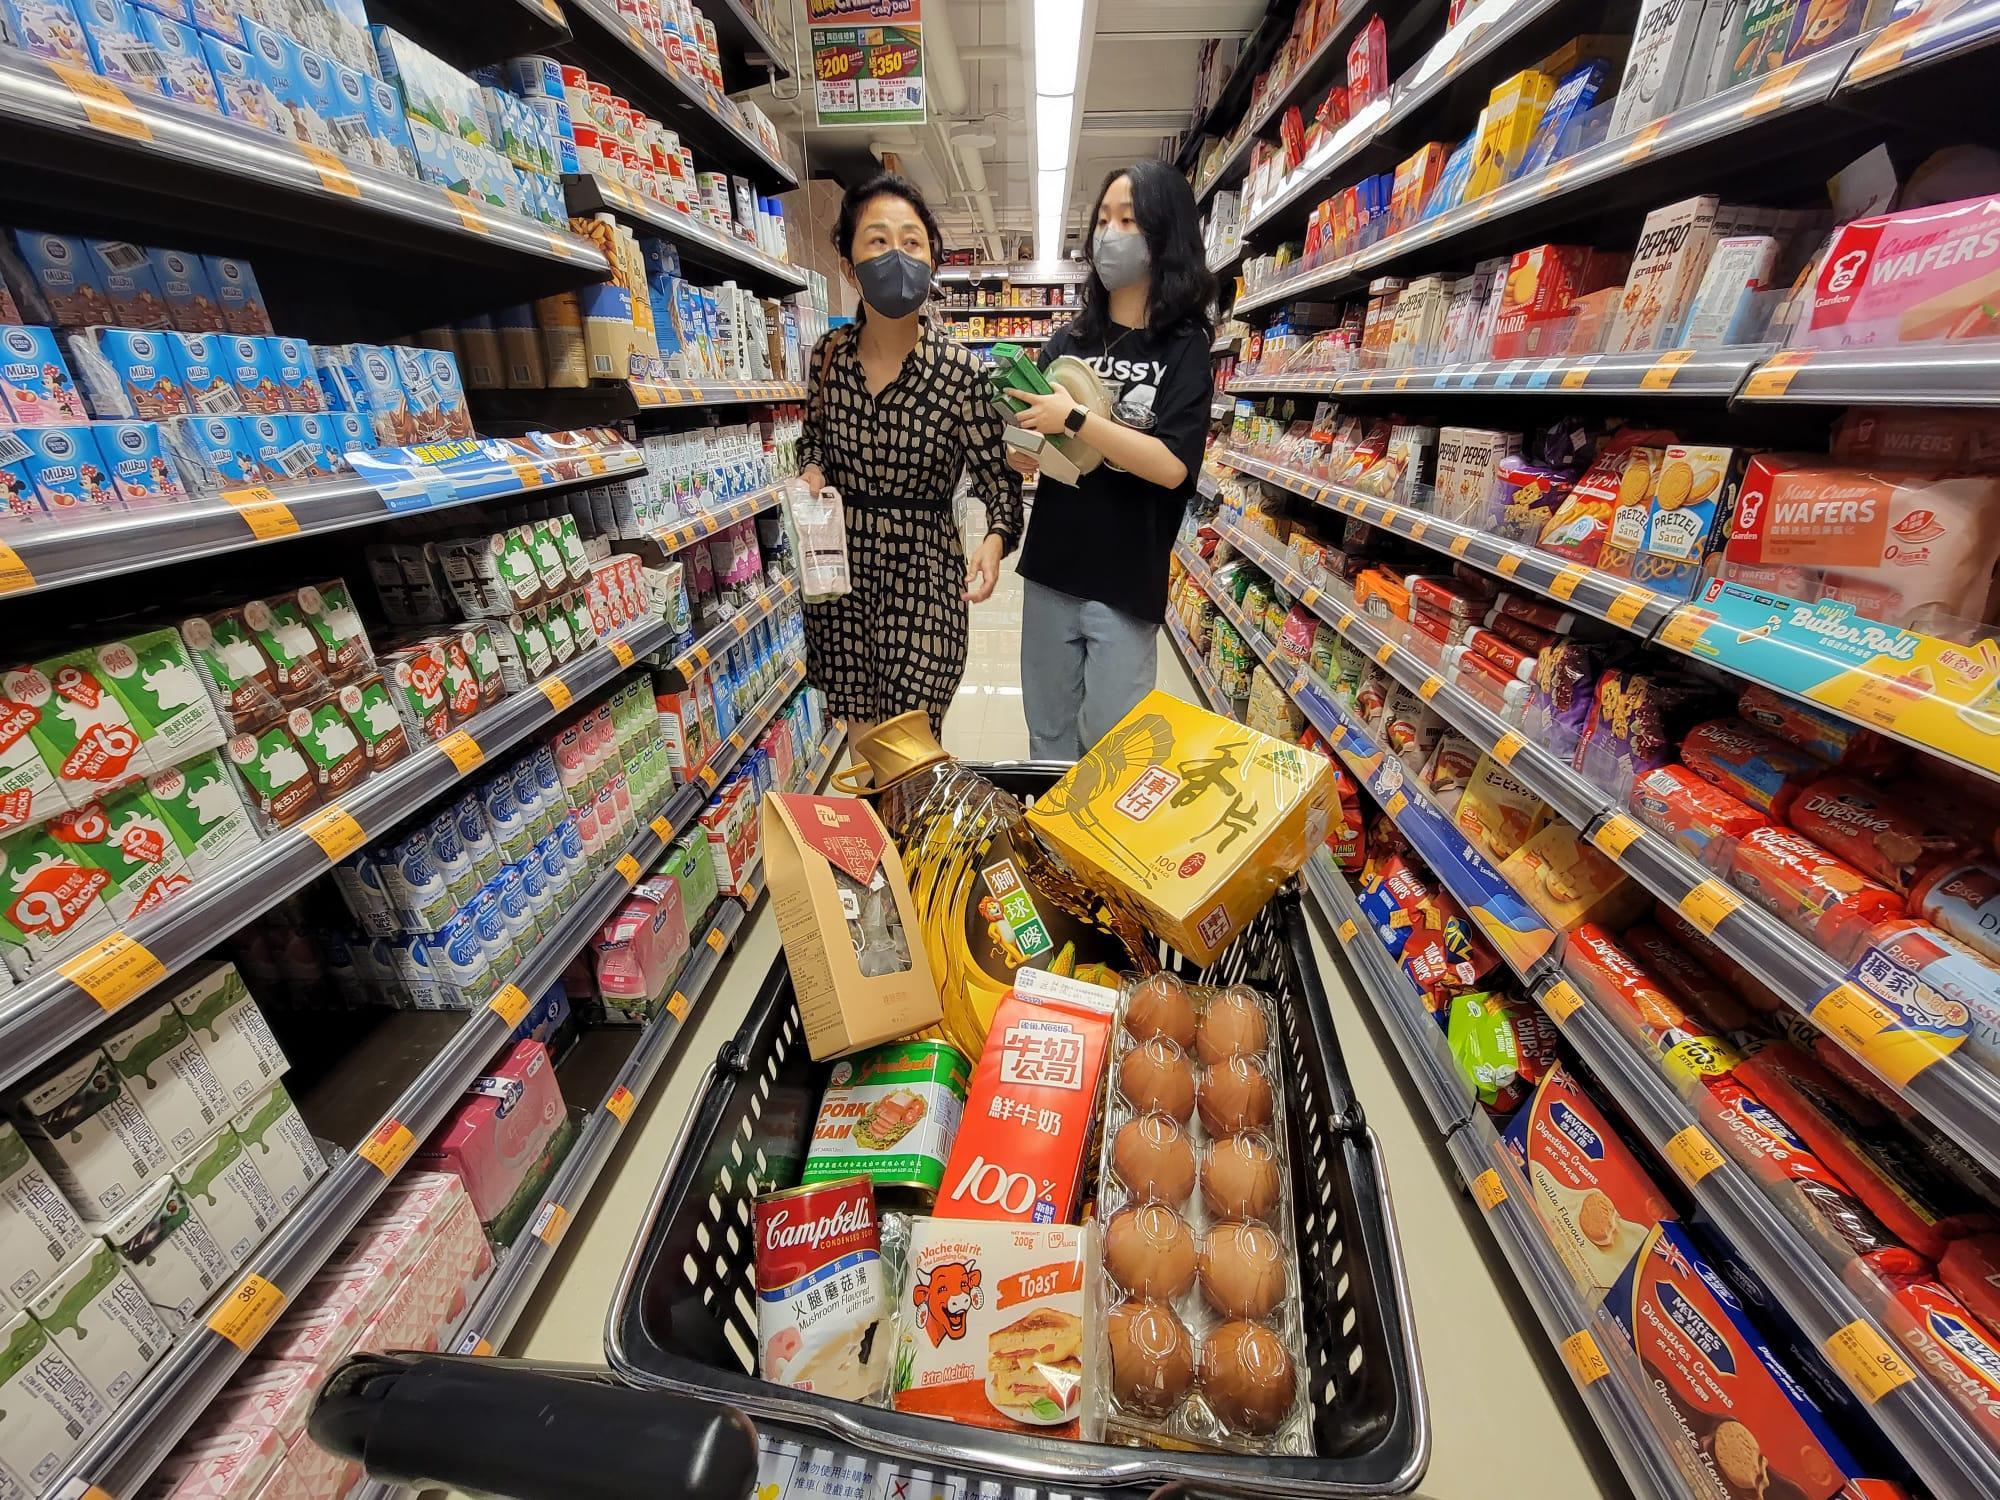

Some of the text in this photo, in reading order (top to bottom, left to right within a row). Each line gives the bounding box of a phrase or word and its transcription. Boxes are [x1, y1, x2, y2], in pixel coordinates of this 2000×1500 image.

[870, 2, 910, 16] Crazy Deal
[1745, 8, 1795, 36] almond
[1635, 222, 1691, 262] PEPERO
[1633, 259, 1673, 279] granola
[1814, 294, 1851, 309] Garden
[1495, 314, 1528, 335] MARIE
[5, 365, 37, 378] Milky
[131, 366, 154, 379] Milky
[188, 367, 208, 378] Milky
[238, 368, 257, 379] Milky
[212, 451, 231, 462] Milky
[1440, 442, 1460, 462] PEPERO
[1461, 444, 1493, 467] PEPERO
[44, 467, 76, 481] Milky
[120, 460, 146, 473] Milky
[1617, 509, 1648, 530] PRETZEL
[1774, 499, 1876, 524] WAFERS
[1618, 524, 1639, 538] Sand
[1654, 513, 1697, 537] PRETZEL
[1731, 530, 1758, 541] Garden
[1658, 531, 1684, 545] Sand
[1368, 602, 1387, 619] CLUB
[1789, 606, 1863, 643] Butter
[67, 688, 96, 708] PACKS
[376, 736, 395, 755] 朱古力
[330, 762, 352, 782] 朱古力
[1127, 776, 1171, 813] 車仔
[1485, 772, 1542, 801] ミニビスケッ
[273, 789, 300, 812] 朱古力
[1804, 796, 1889, 832] Digestive
[62, 873, 106, 915] PACKS
[1388, 877, 1411, 900] CHIPS
[1945, 880, 1984, 904] BISCA
[990, 868, 1045, 949] 獅球嘜
[1412, 957, 1432, 981] CHIPS
[1886, 944, 1921, 971] BISCA
[1861, 974, 1898, 1001] Exclusive
[1863, 956, 1913, 997] 獨家
[1008, 1034, 1080, 1062] 牛奶
[1516, 1018, 1540, 1058] CHIPS
[1011, 1059, 1077, 1084] 公司
[820, 1102, 872, 1118] PORK
[988, 1095, 1062, 1136] 鮮牛奶
[1561, 1111, 1595, 1144] McVitie's
[1718, 1109, 1789, 1160] Digestive
[1536, 1120, 1570, 1158] Digestives
[1571, 1156, 1599, 1185] Creams
[1536, 1170, 1559, 1207] Vanilla
[1558, 1206, 1585, 1248] Flavour
[767, 1197, 872, 1250] Campbell's
[820, 1234, 860, 1249] CONDENSED
[1014, 1236, 1034, 1249] 200g
[792, 1267, 867, 1320] 火腿蘑菇湯
[799, 1286, 870, 1330] Mushroom Flavored
[846, 1302, 862, 1314] with
[1673, 1296, 1720, 1351] McVitie's
[1640, 1301, 1690, 1362] Digestives
[1693, 1362, 1734, 1409] Creams
[921, 1364, 975, 1385] Extra Melting
[1905, 1328, 2000, 1419] Digestive
[1654, 1379, 1700, 1451] Chocolate
